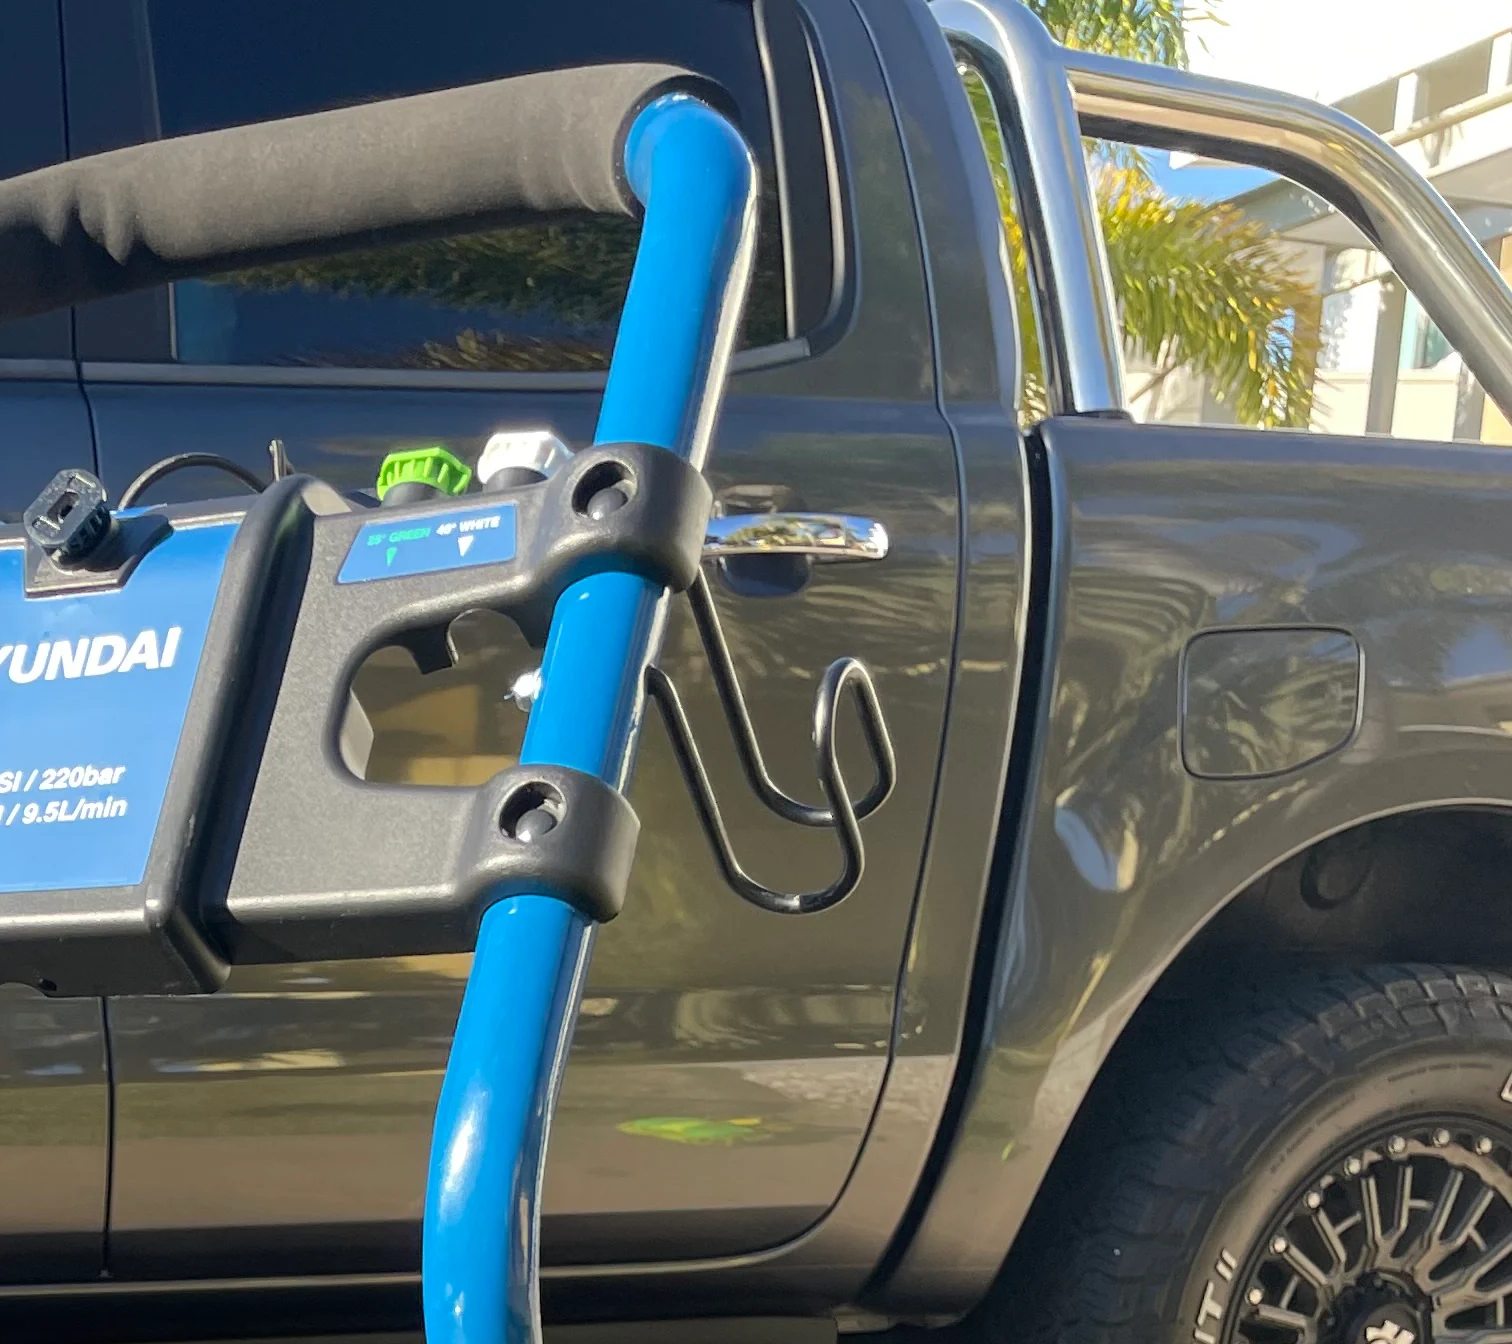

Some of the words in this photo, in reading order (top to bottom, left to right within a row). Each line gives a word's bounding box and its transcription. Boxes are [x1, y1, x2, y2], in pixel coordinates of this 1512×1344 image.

[459, 515, 501, 533] WHITE
[39, 764, 126, 790] 220bar
[22, 796, 128, 824] 9.5L/min
